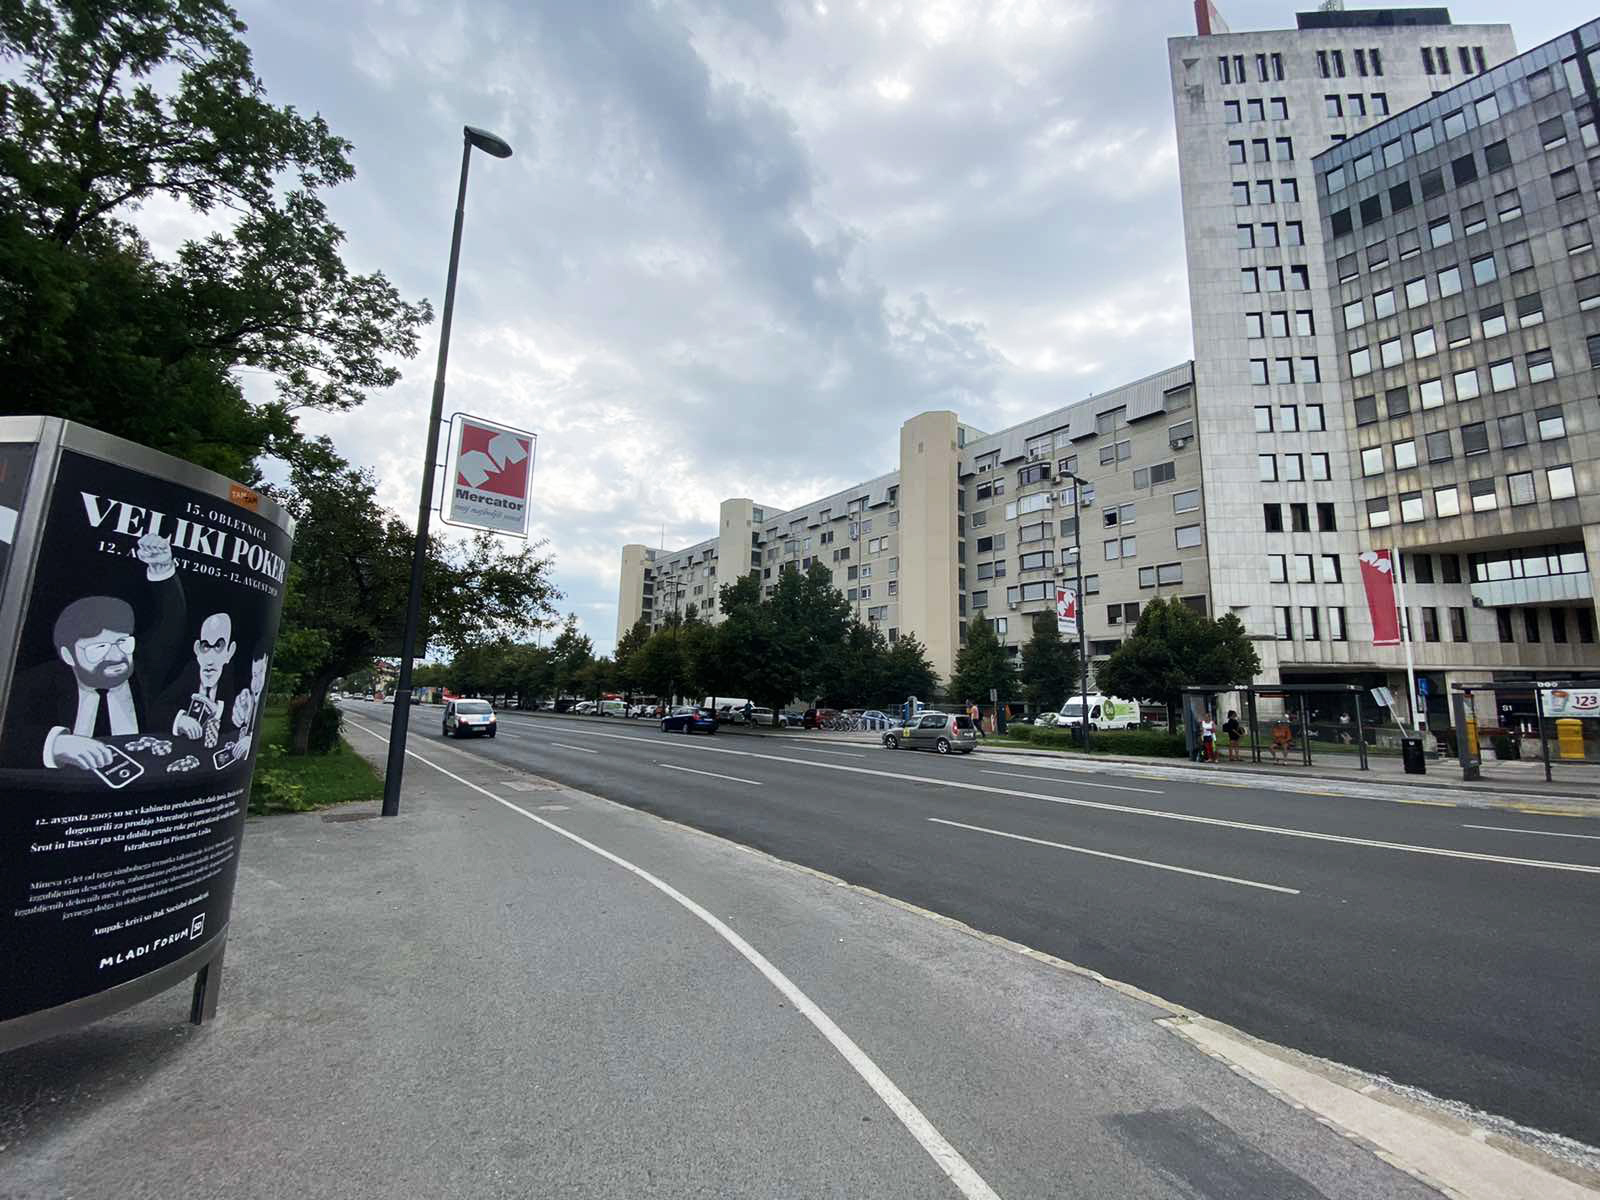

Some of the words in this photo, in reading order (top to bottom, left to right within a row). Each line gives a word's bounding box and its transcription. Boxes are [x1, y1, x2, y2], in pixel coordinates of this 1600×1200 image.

[456, 488, 524, 511] Mercator
[186, 502, 205, 517] 15.
[209, 510, 267, 541] OBLETNICA
[80, 491, 228, 559] VELIKI
[230, 536, 286, 584] POKER
[98, 541, 122, 555] 12.
[192, 562, 222, 577] 2005
[230, 572, 242, 583] 12.
[1575, 695, 1598, 706] 123
[50, 814, 88, 825] avgusta
[64, 822, 112, 836] dogovorili
[30, 841, 52, 854] Šrot
[54, 841, 65, 850] in
[99, 944, 150, 969] MLADI
[152, 927, 189, 951] FORUM
